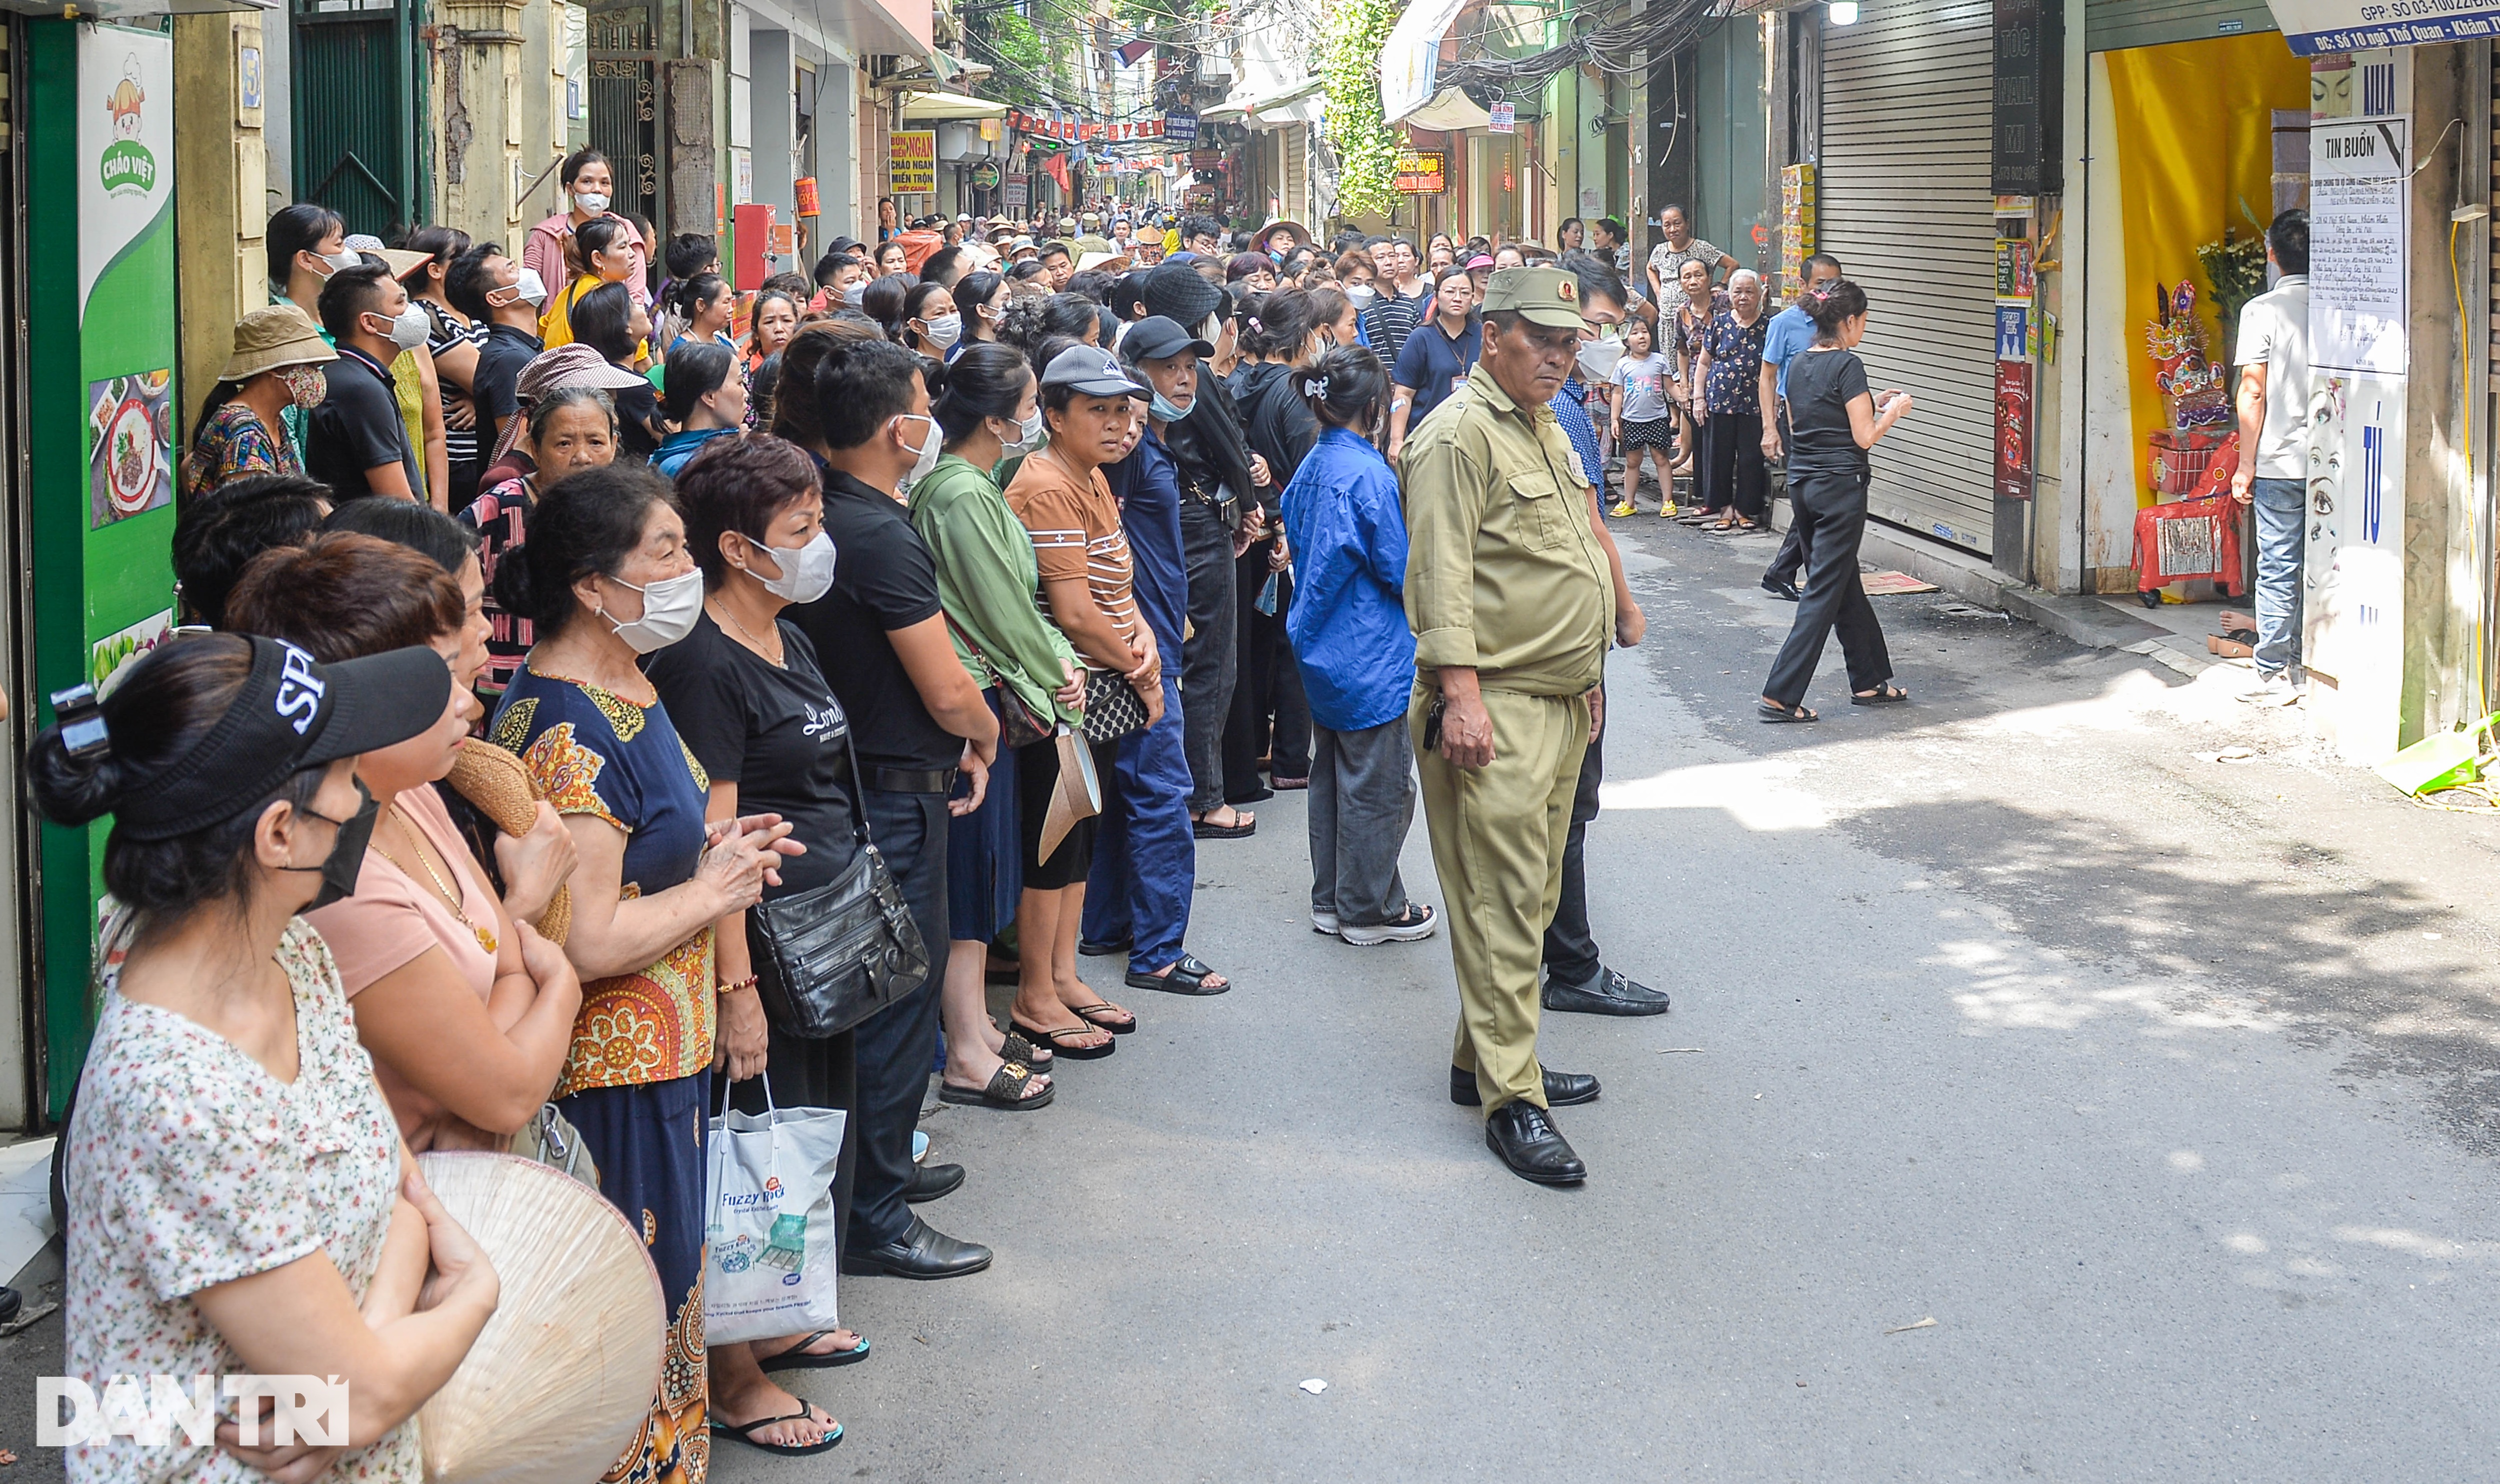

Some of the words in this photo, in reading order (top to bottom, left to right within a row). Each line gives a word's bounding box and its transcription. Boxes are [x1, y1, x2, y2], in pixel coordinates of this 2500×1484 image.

[2362, 5, 2392, 20] GPP:
[2314, 36, 2336, 50] ĐC:
[2334, 31, 2351, 48] Số
[2350, 32, 2367, 46] 10
[2388, 23, 2412, 42] Thổ
[2411, 25, 2444, 41] Quan
[2450, 19, 2491, 36] Khâm
[246, 59, 259, 96] 5
[1998, 76, 2033, 105] NAIL
[908, 136, 932, 158] NGAN
[2005, 124, 2025, 153] MI
[2326, 138, 2341, 159] TIN
[2344, 128, 2376, 157] BUỒN
[891, 147, 906, 157] MIẾN
[891, 159, 910, 169] CHÁO
[912, 160, 933, 169] NGAN
[1634, 144, 1642, 164] 16
[103, 150, 130, 180] CHÁO
[131, 155, 154, 183] VIỆT
[892, 171, 911, 183] MIẾN
[913, 172, 933, 185] TRỘN
[274, 638, 326, 735] SP
[722, 1191, 760, 1207] Fuzzy
[763, 1184, 786, 1203] Rock
